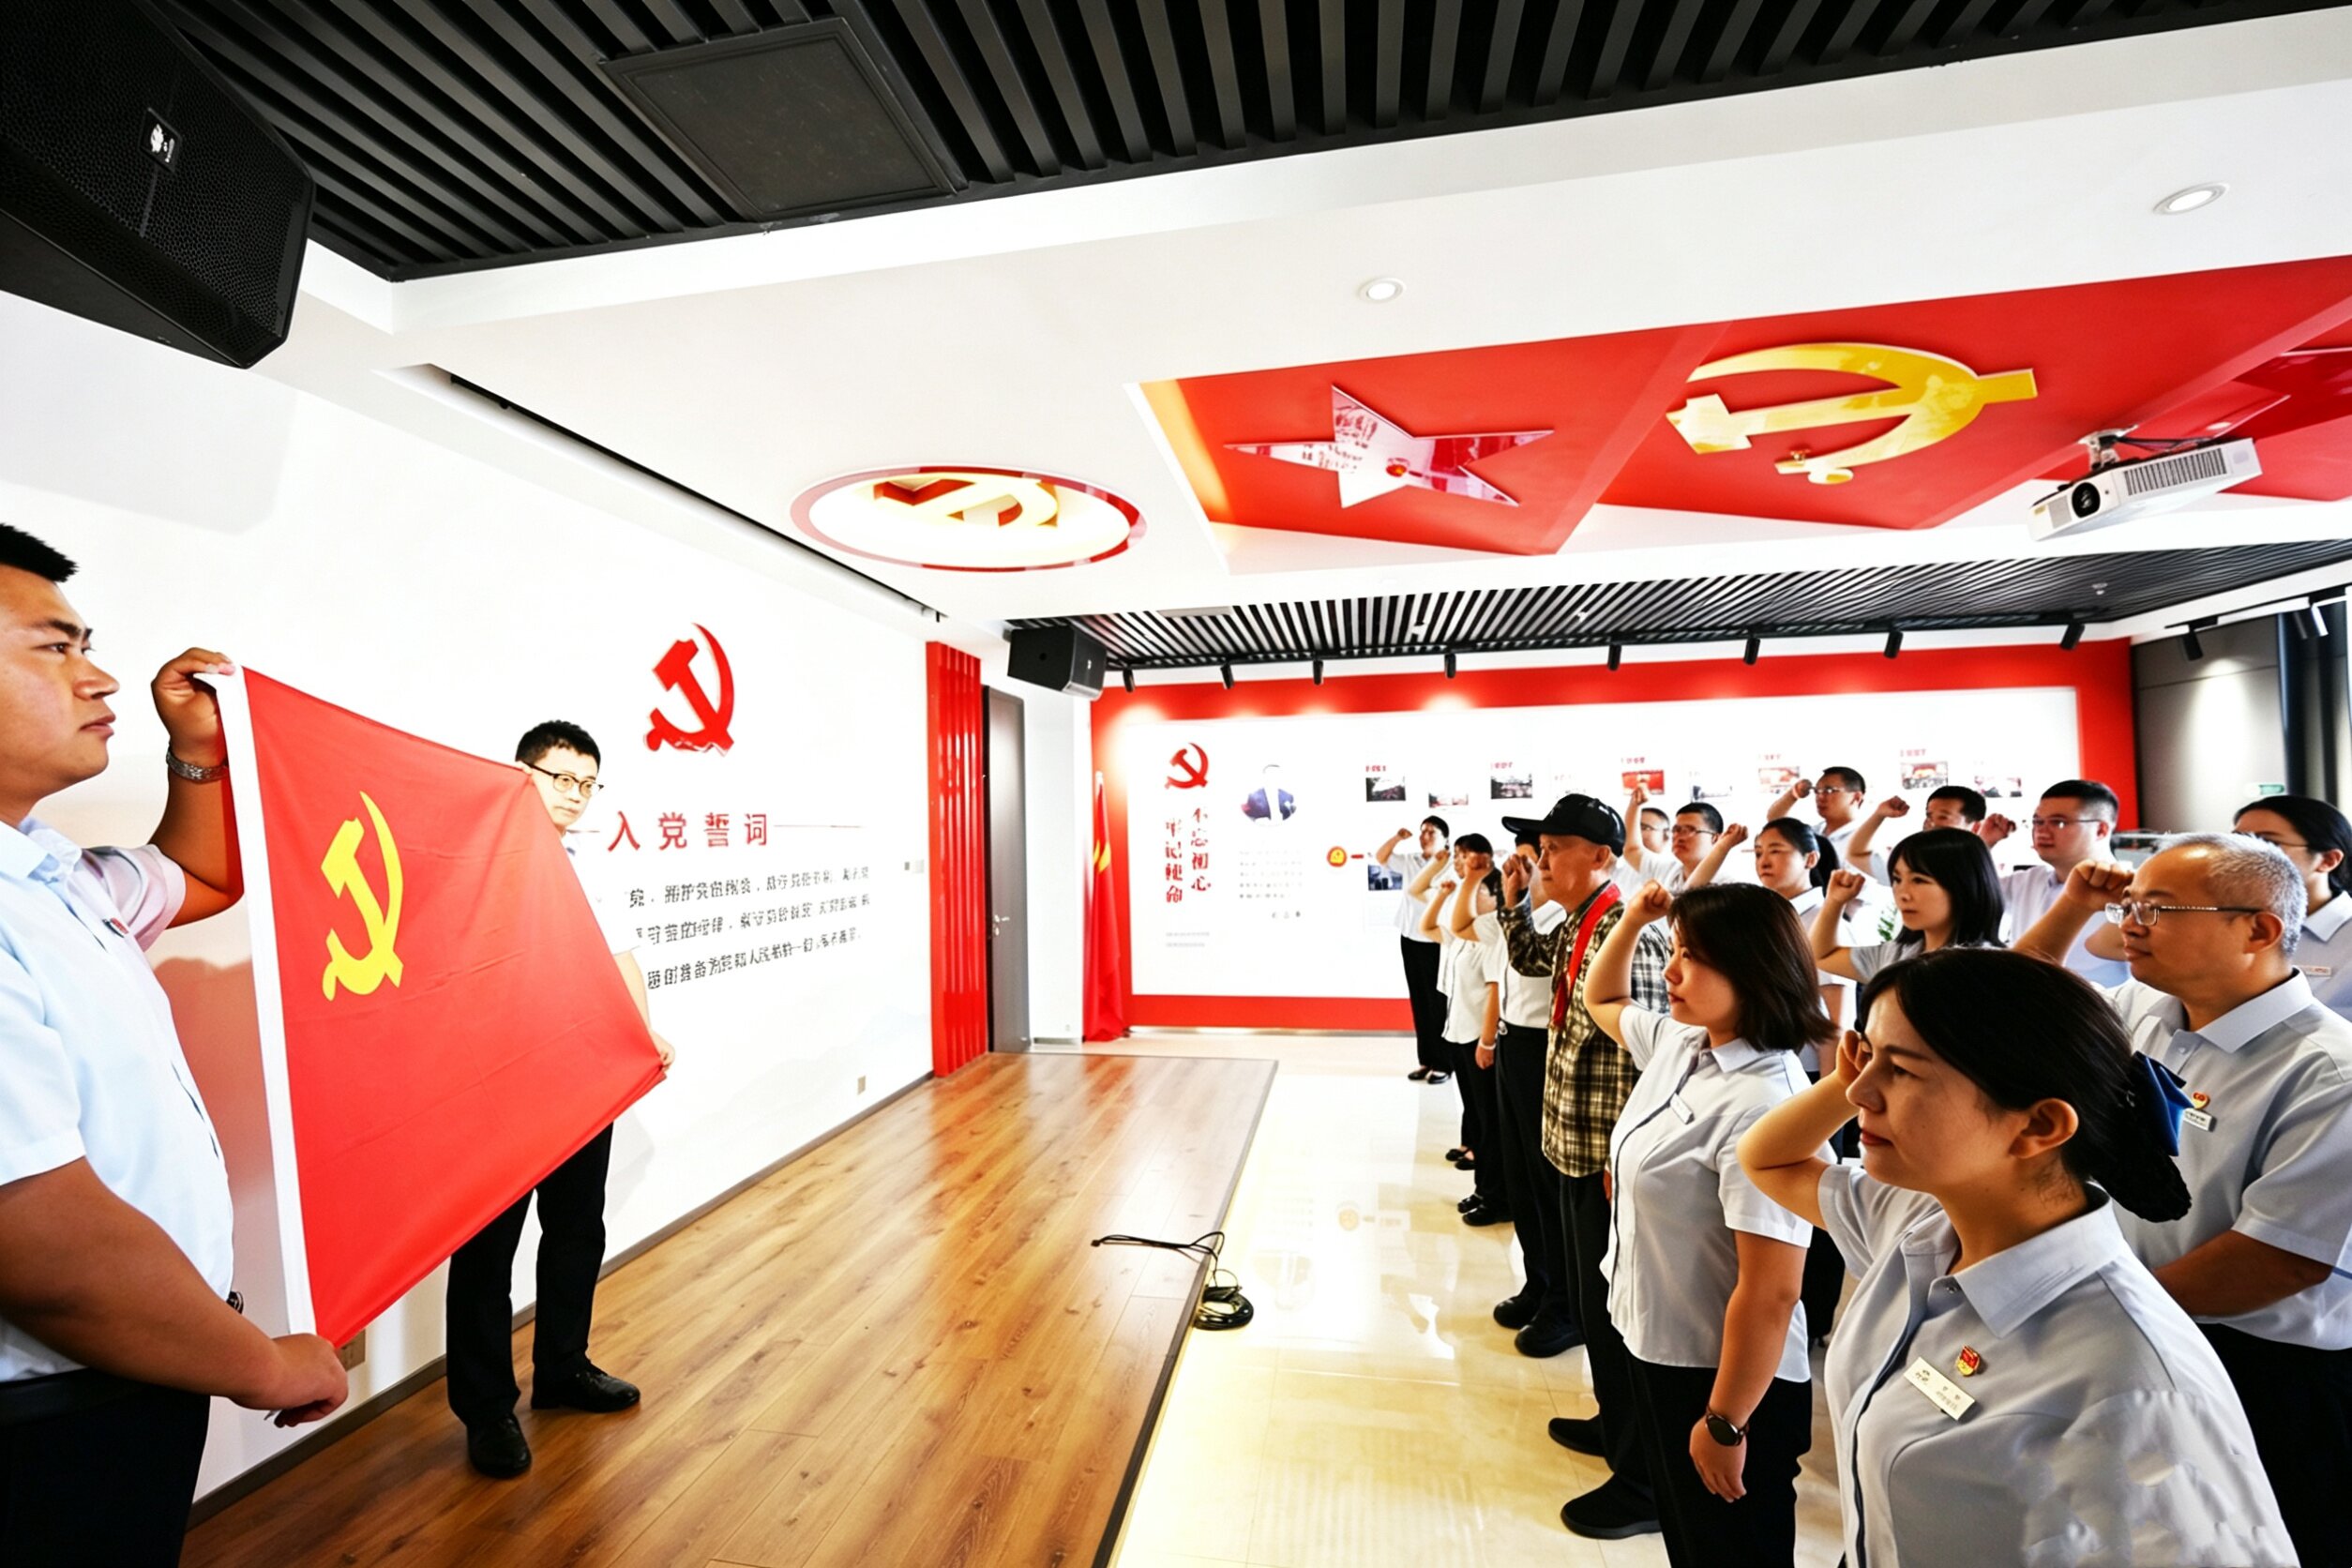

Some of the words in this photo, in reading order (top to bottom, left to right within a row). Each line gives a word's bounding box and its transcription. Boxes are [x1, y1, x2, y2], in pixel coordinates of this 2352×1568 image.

[607, 810, 768, 852] 入党誓词
[1165, 818, 1184, 903] 牢记使命
[1190, 807, 1212, 892] 不忘初心
